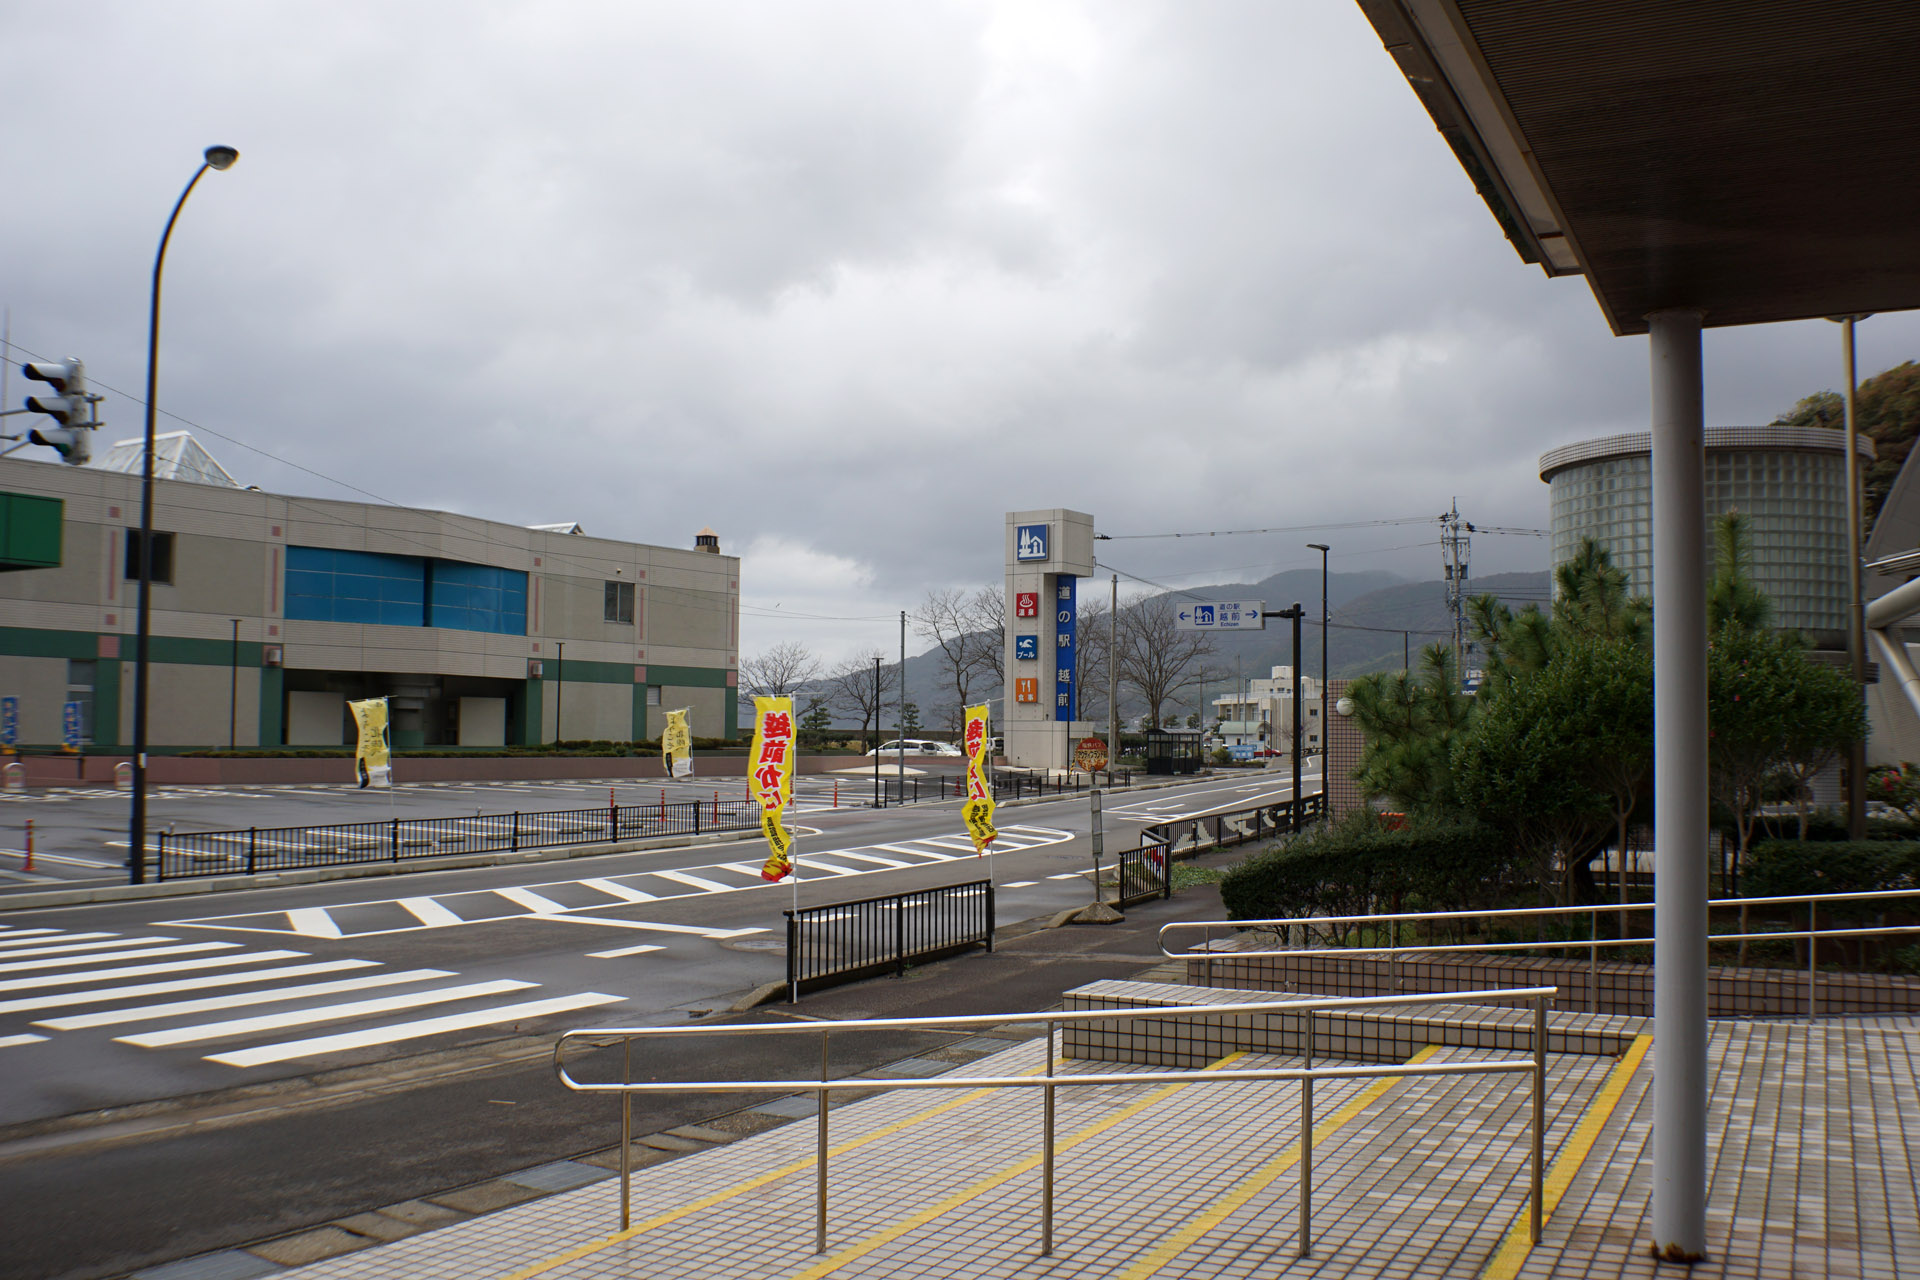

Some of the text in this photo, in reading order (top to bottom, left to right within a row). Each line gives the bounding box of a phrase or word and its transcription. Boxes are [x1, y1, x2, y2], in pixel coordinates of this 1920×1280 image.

[1018, 608, 1035, 616] 温泉
[1220, 612, 1240, 621] 越前
[1058, 586, 1071, 707] 道の駅 越前
[1017, 650, 1035, 659] プール
[1018, 693, 1035, 702] 食事
